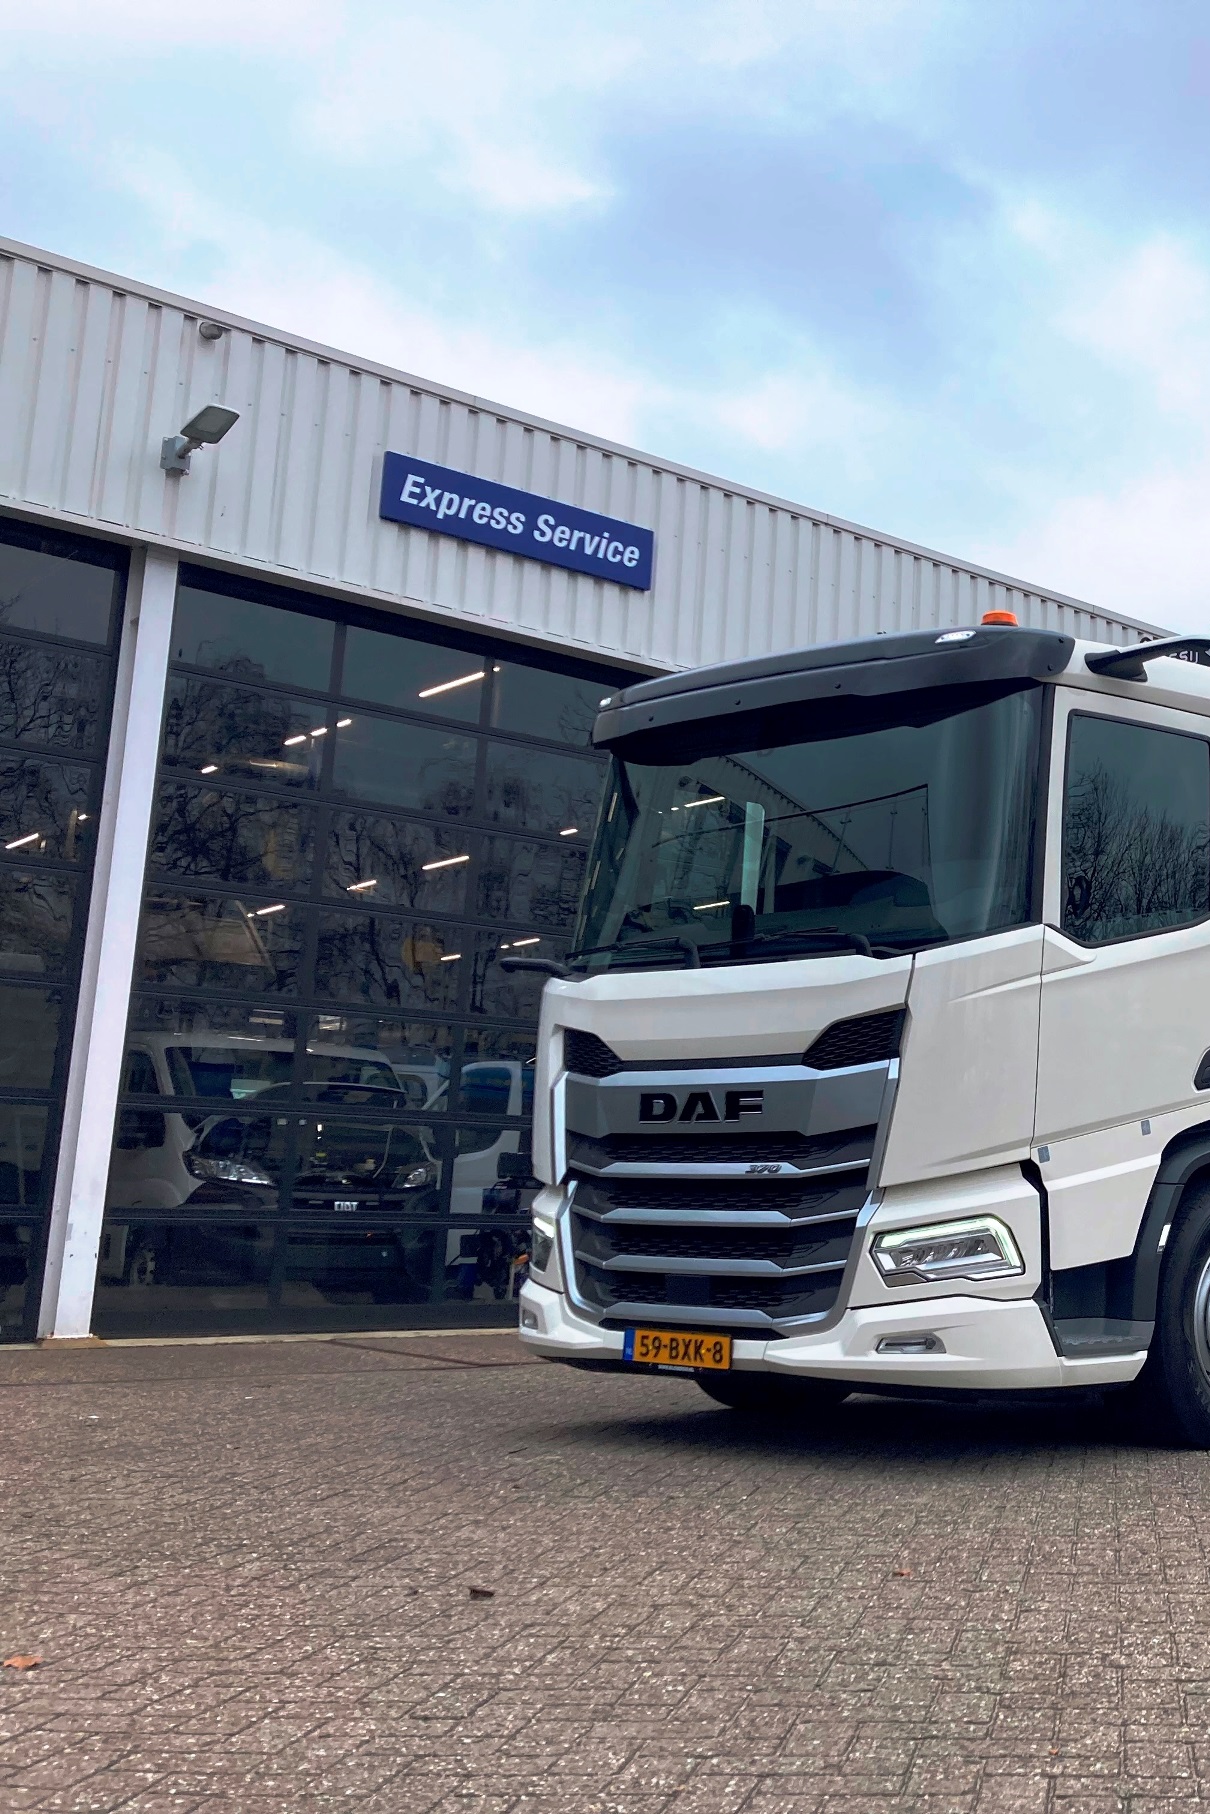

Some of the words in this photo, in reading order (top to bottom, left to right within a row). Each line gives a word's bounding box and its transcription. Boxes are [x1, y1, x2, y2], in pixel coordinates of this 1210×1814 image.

[400, 474, 526, 535] Express
[533, 514, 640, 568] Service
[639, 1089, 764, 1124] DAF
[640, 1335, 723, 1364] 59-BXK-8
